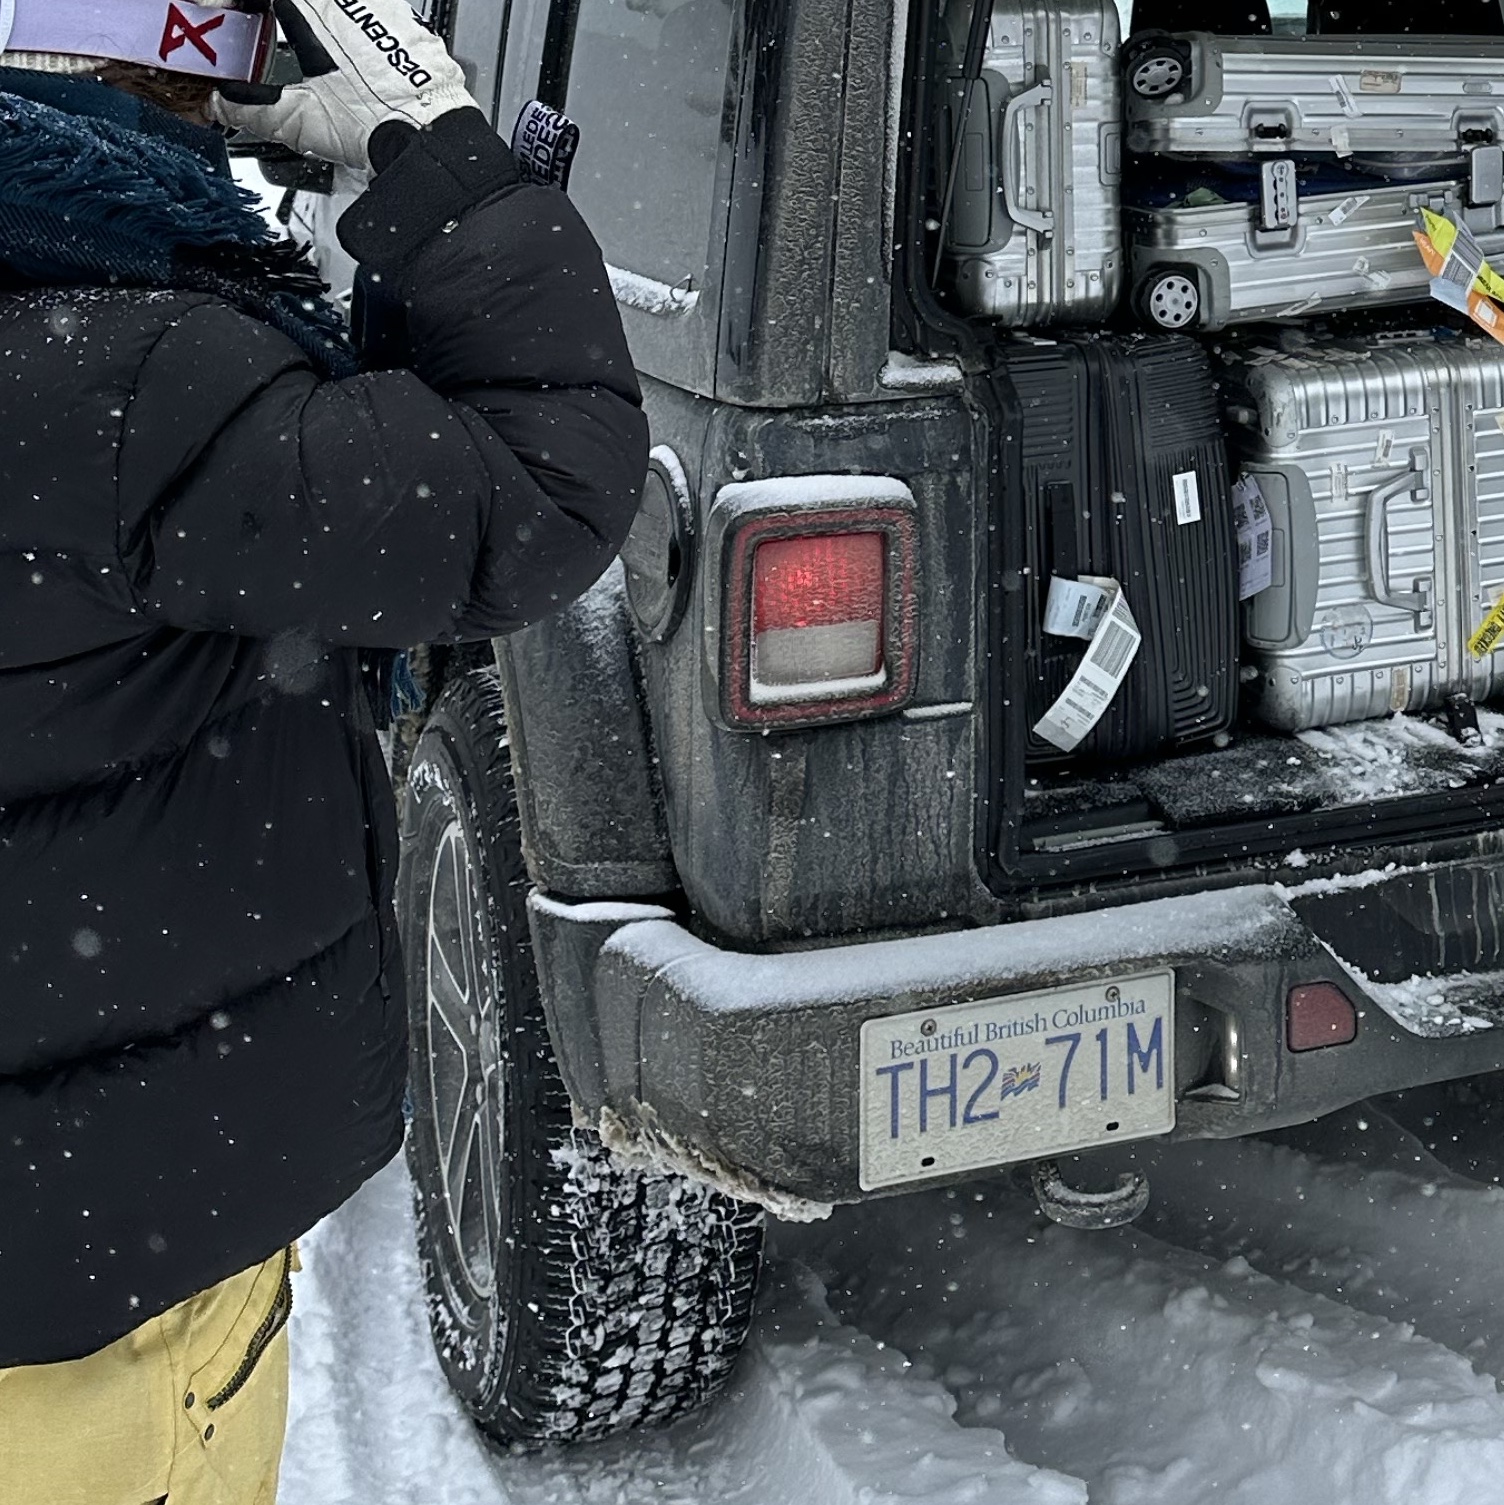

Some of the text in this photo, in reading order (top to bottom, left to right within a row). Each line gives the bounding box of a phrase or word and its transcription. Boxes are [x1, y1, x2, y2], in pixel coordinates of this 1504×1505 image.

[890, 998, 1146, 1060] Beautiful British Columbia
[876, 1016, 1163, 1140] TH2 71M
